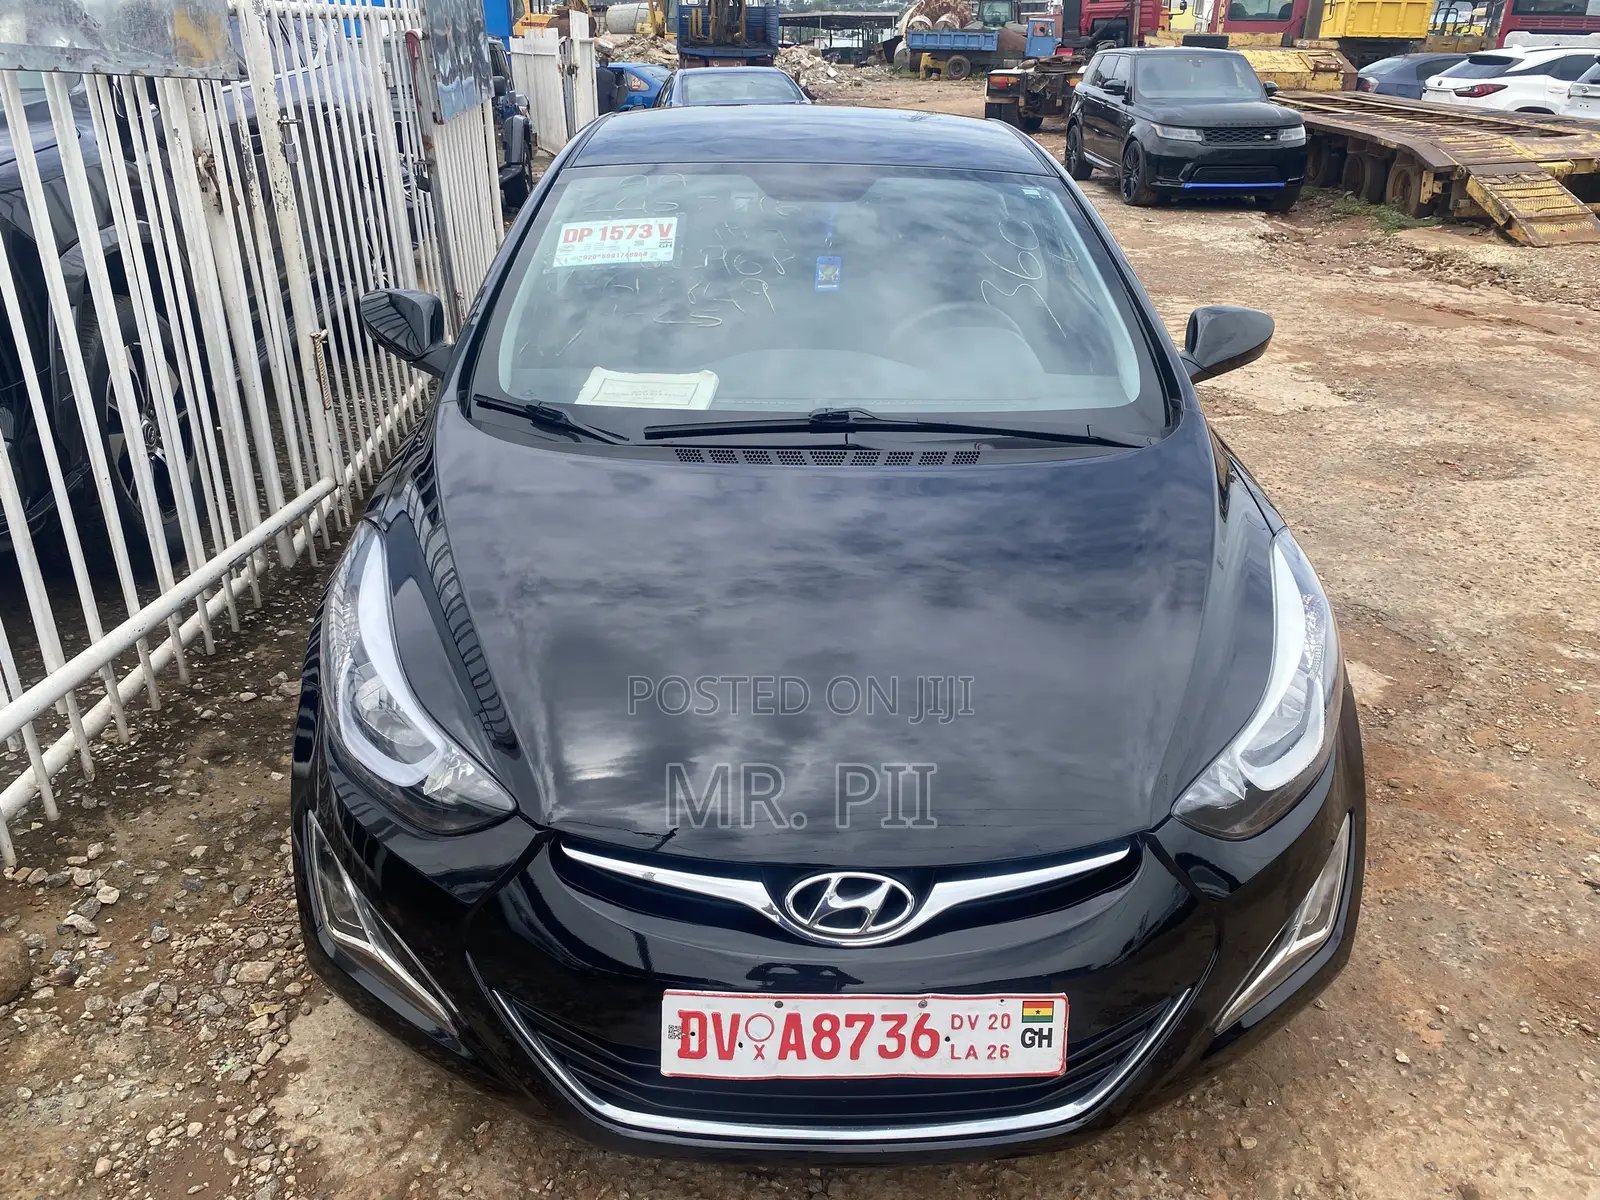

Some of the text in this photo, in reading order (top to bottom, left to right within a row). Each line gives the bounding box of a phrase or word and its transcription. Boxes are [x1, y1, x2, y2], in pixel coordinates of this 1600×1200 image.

[562, 223, 673, 244] DP 1573 V
[950, 1013, 1011, 1031] DV 20
[677, 1009, 742, 1060] DV
[777, 1012, 941, 1060] A8736
[1020, 1027, 1053, 1050] GH
[950, 1043, 1010, 1060] LA 26
